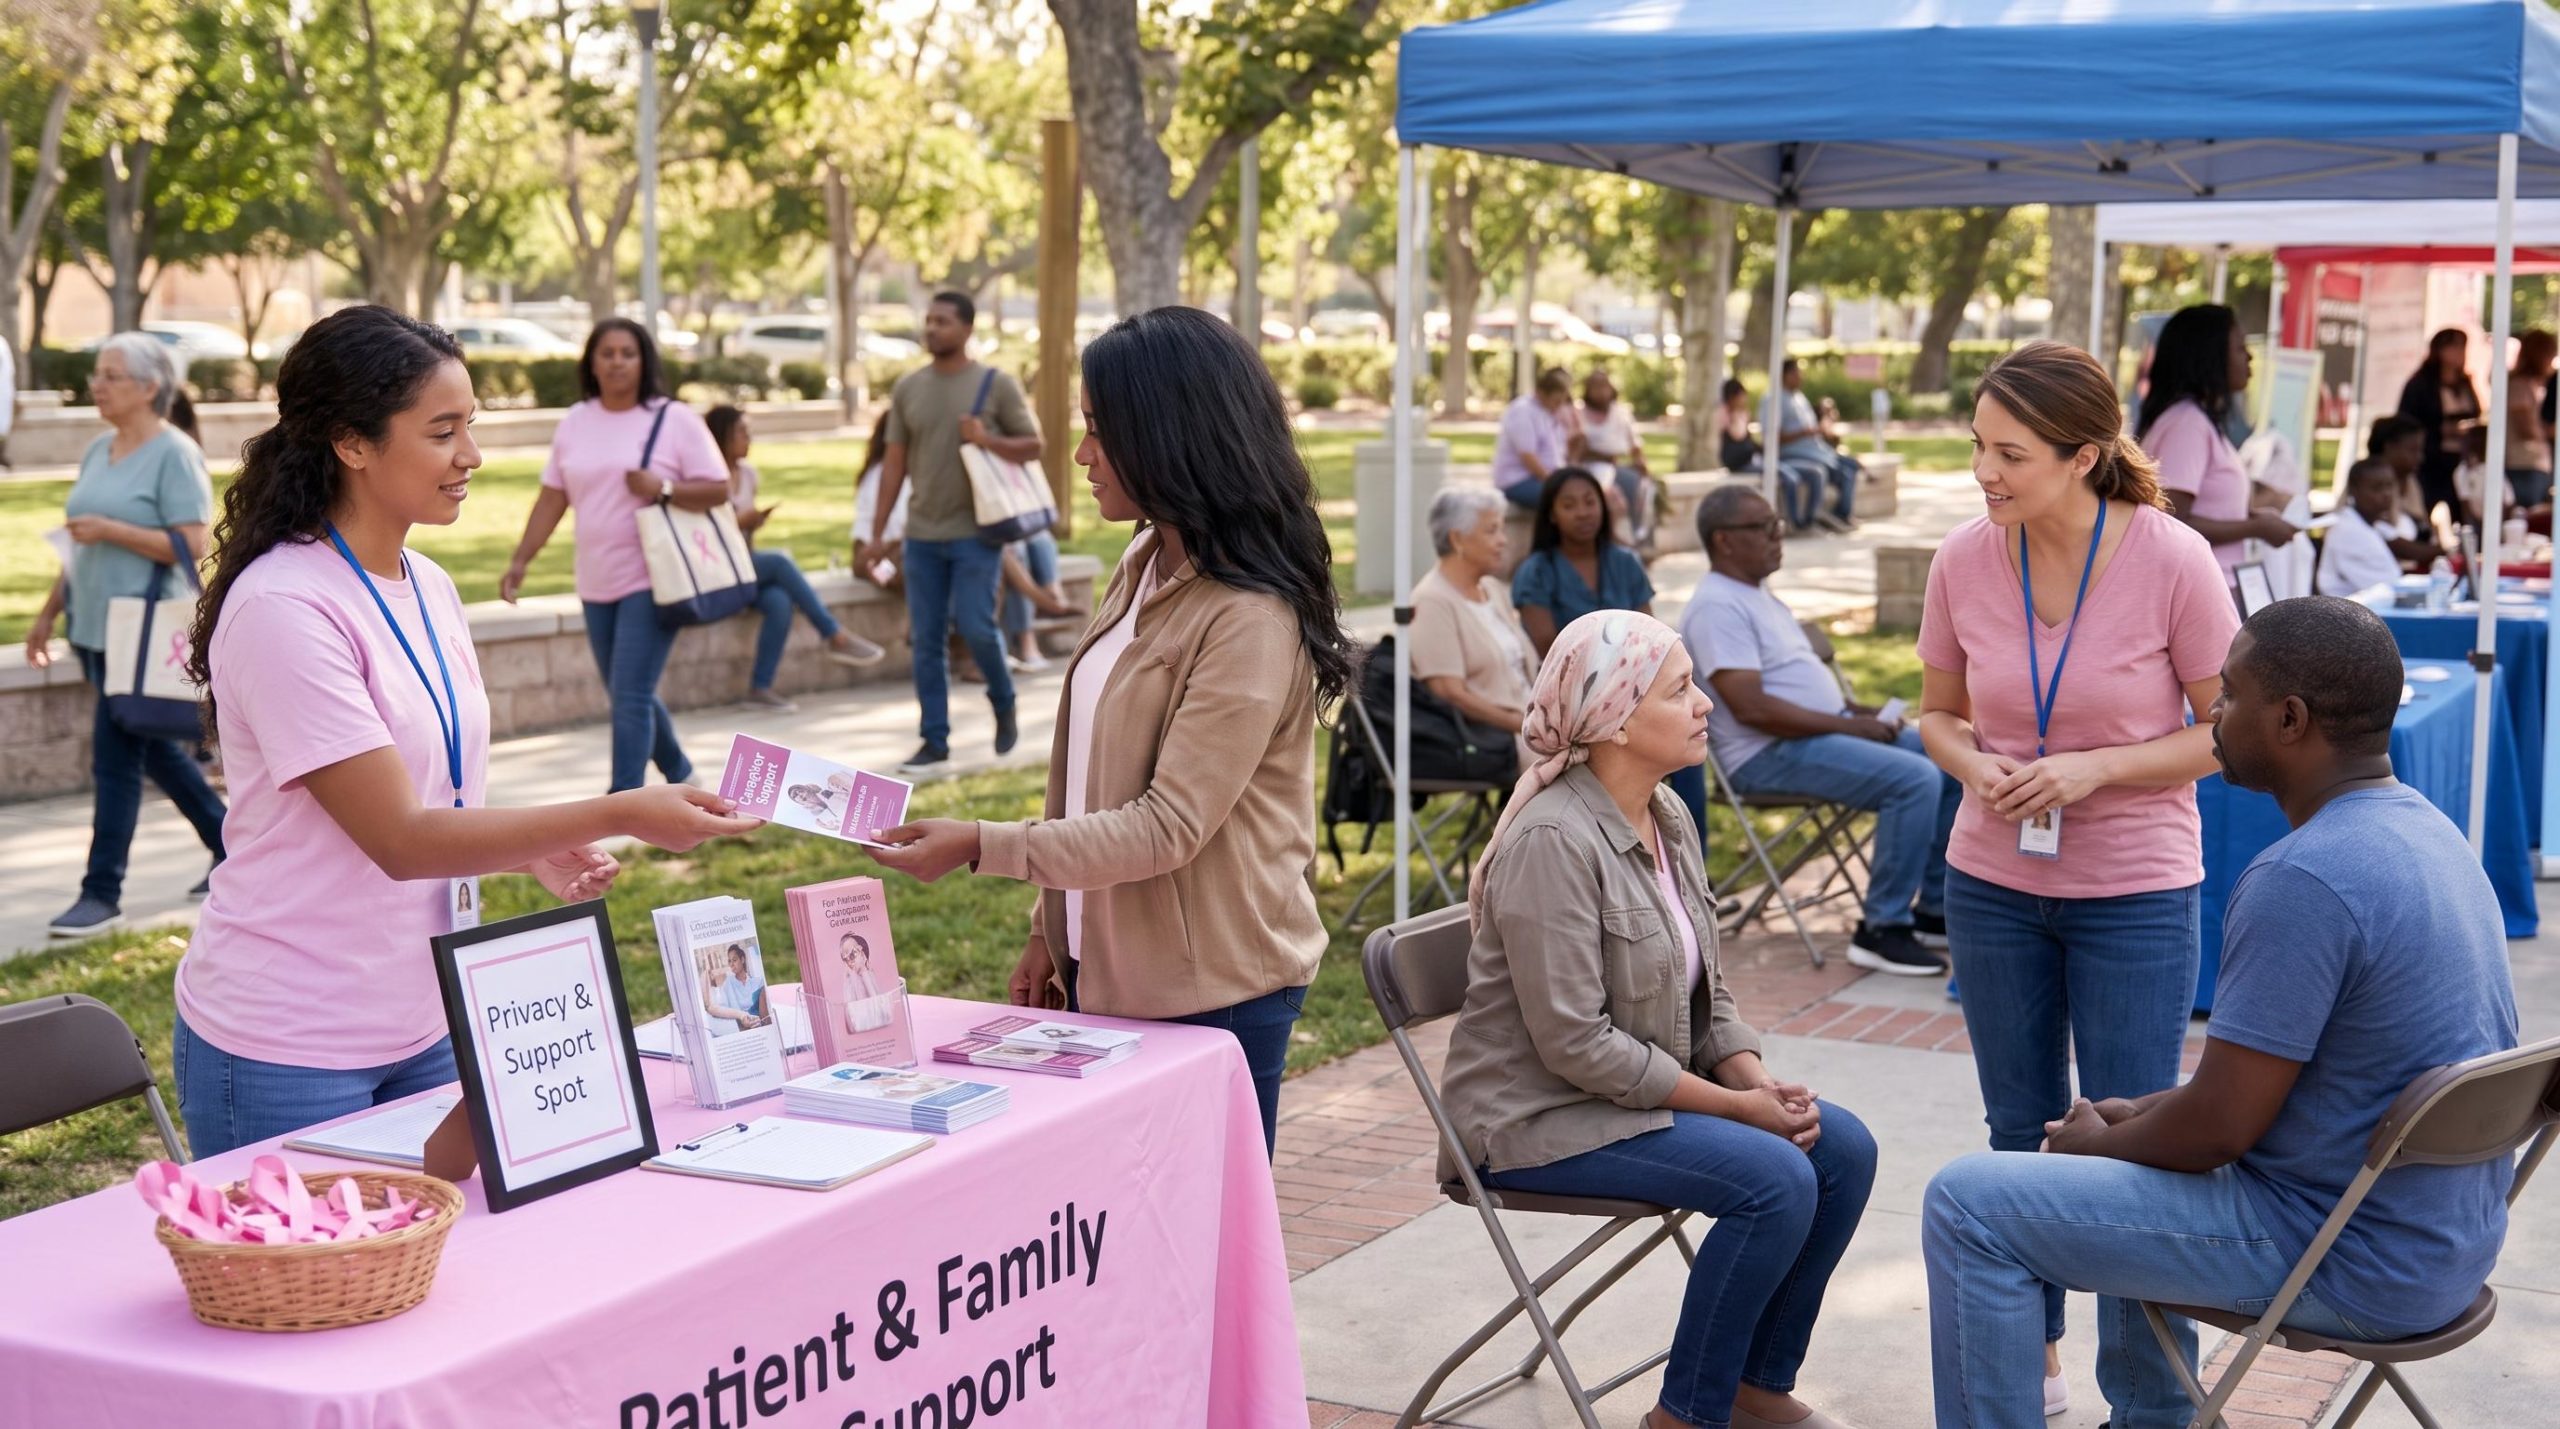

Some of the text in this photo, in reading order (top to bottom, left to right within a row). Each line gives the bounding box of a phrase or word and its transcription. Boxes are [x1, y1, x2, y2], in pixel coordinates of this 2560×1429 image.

[755, 762, 779, 806] Support
[487, 983, 593, 1033] Privacy &
[504, 1028, 596, 1075] Support
[534, 1076, 588, 1114] Spot
[874, 1279, 919, 1362] &
[937, 1201, 1107, 1335] Family
[840, 1324, 1056, 1429] port
